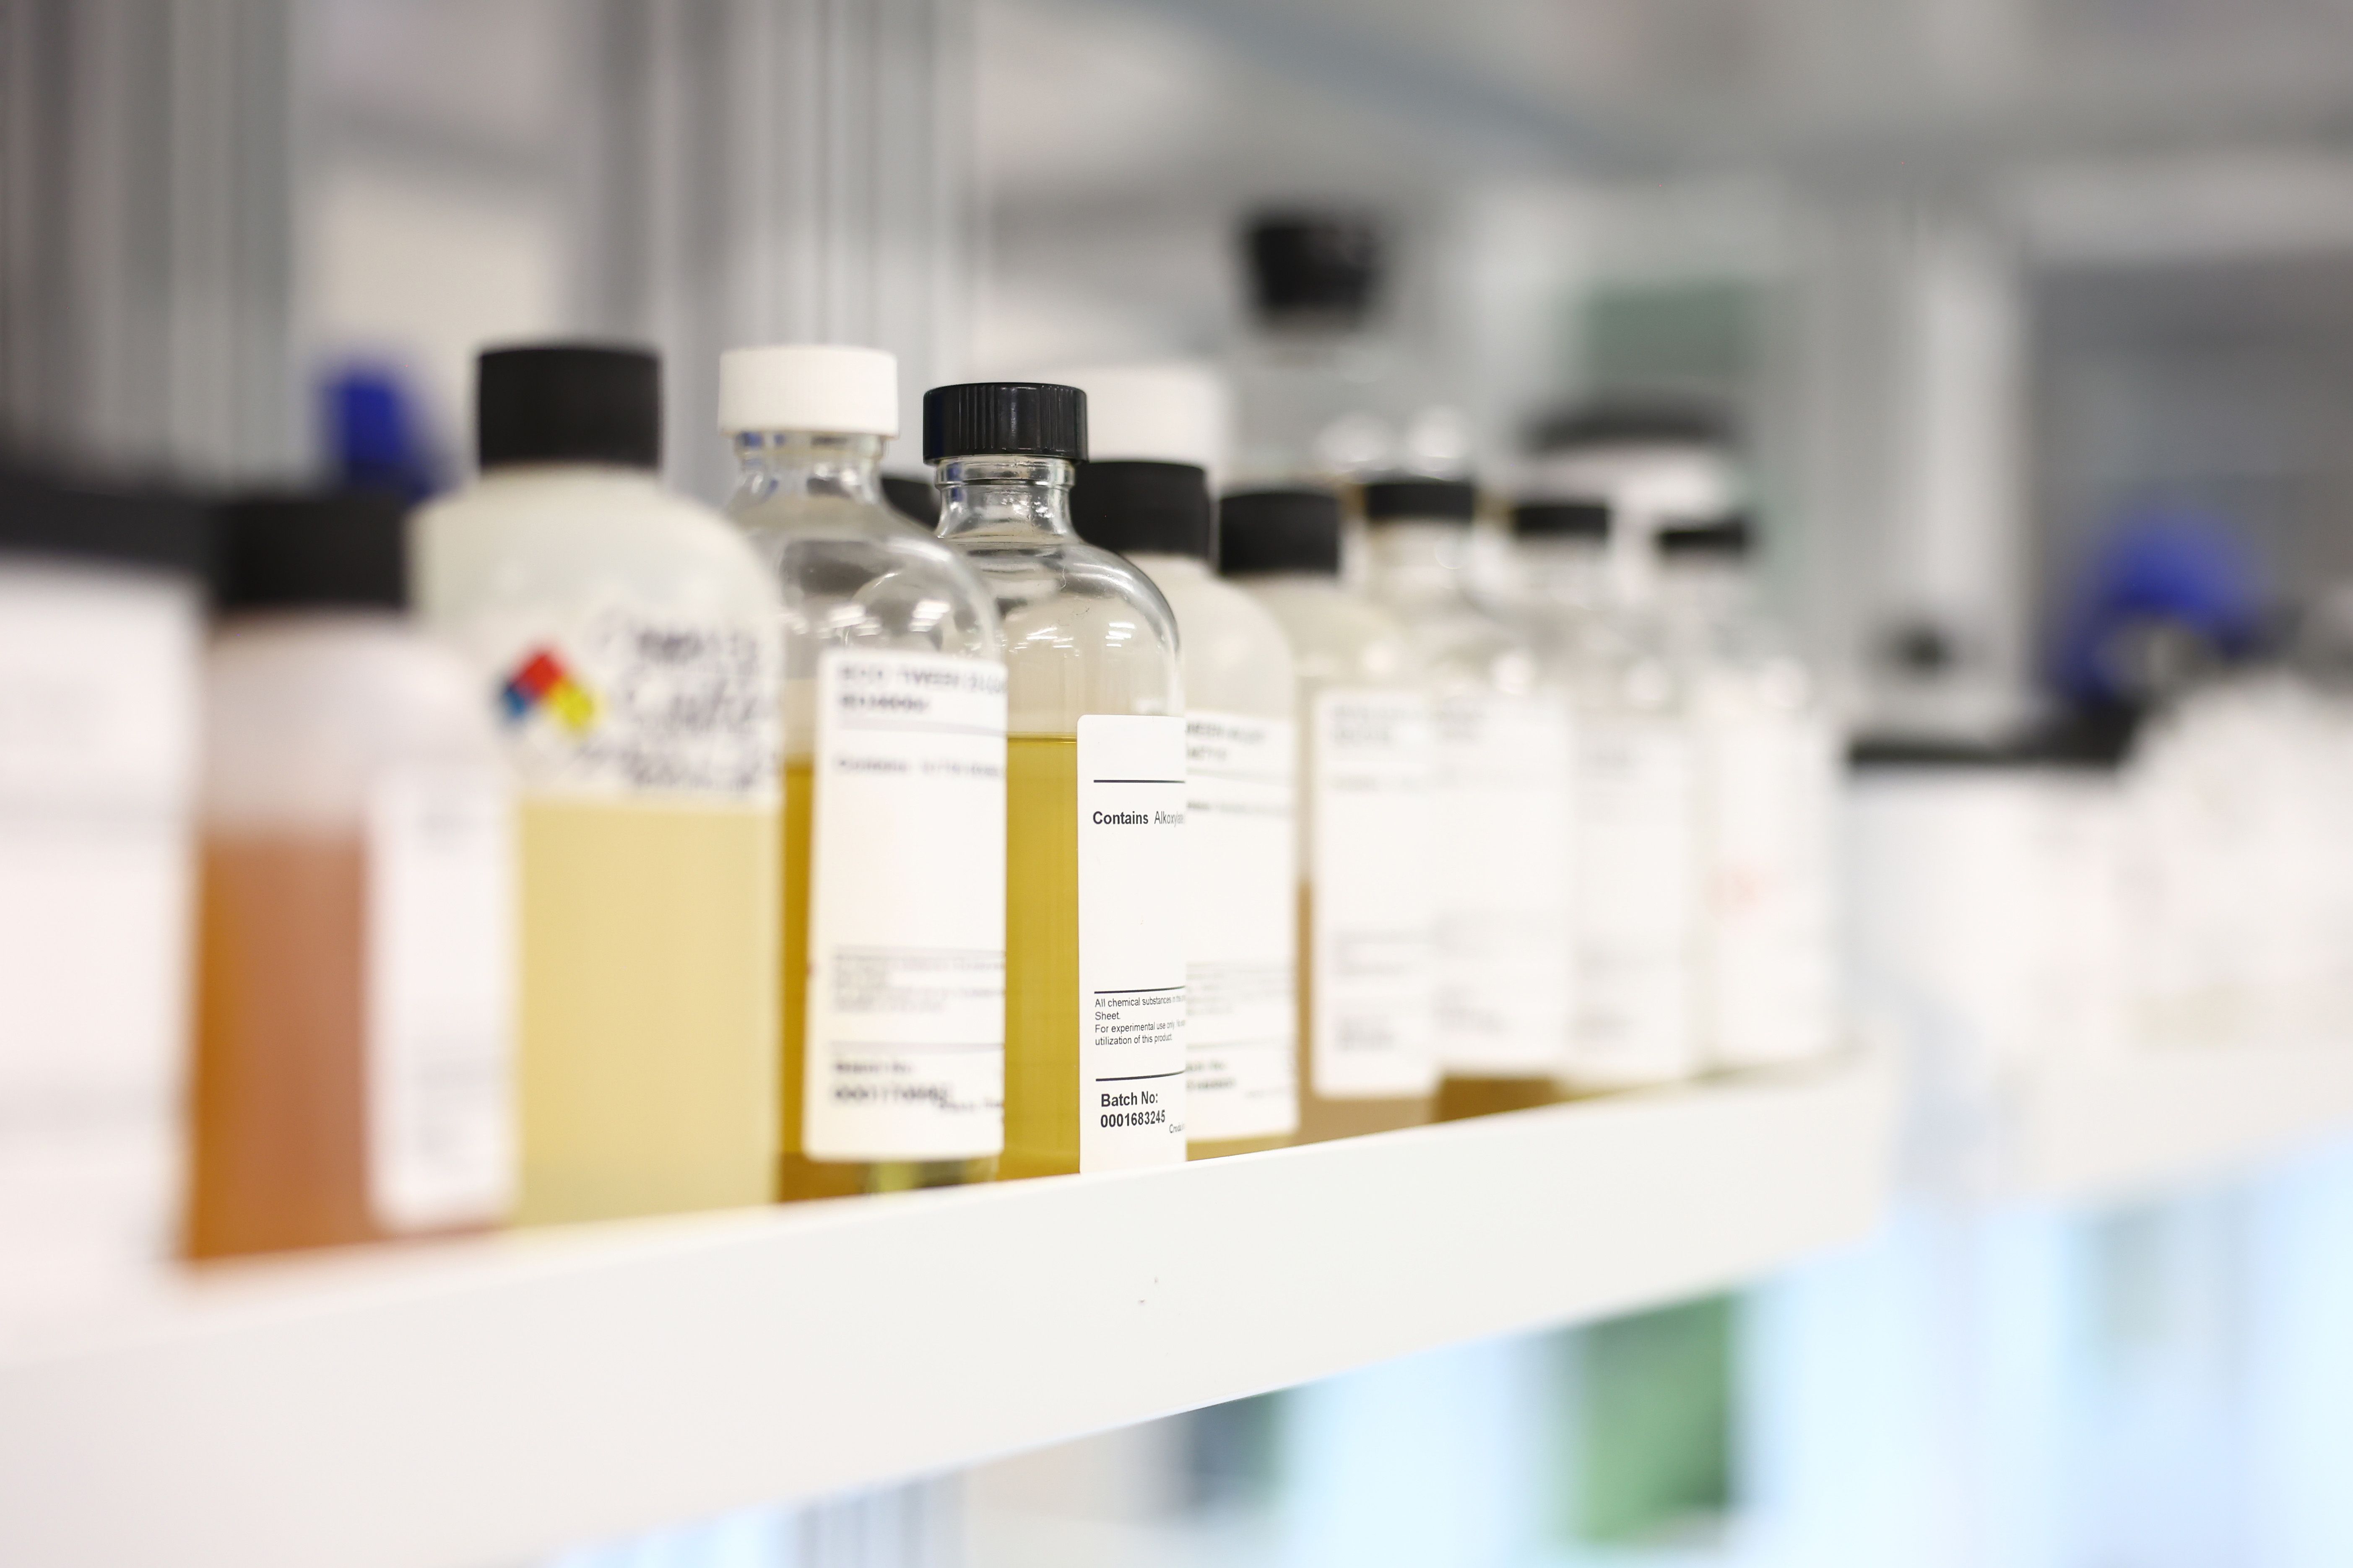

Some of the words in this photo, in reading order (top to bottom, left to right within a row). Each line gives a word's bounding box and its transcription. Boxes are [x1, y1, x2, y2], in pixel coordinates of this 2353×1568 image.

[1093, 811, 1149, 824] Contains
[1095, 998, 1105, 1007] All
[1108, 997, 1140, 1007] chemical
[1143, 996, 1171, 1005] substances
[1095, 1011, 1121, 1020] Sheet.
[1095, 1024, 1108, 1033] For
[1111, 1022, 1155, 1034] experimental
[1095, 1035, 1131, 1045] utilization
[1134, 1035, 1140, 1044] of
[1142, 1034, 1153, 1043] this
[1101, 1092, 1137, 1107] Batch
[1141, 1091, 1158, 1104] No:
[1100, 1109, 1165, 1128] 0001683245
